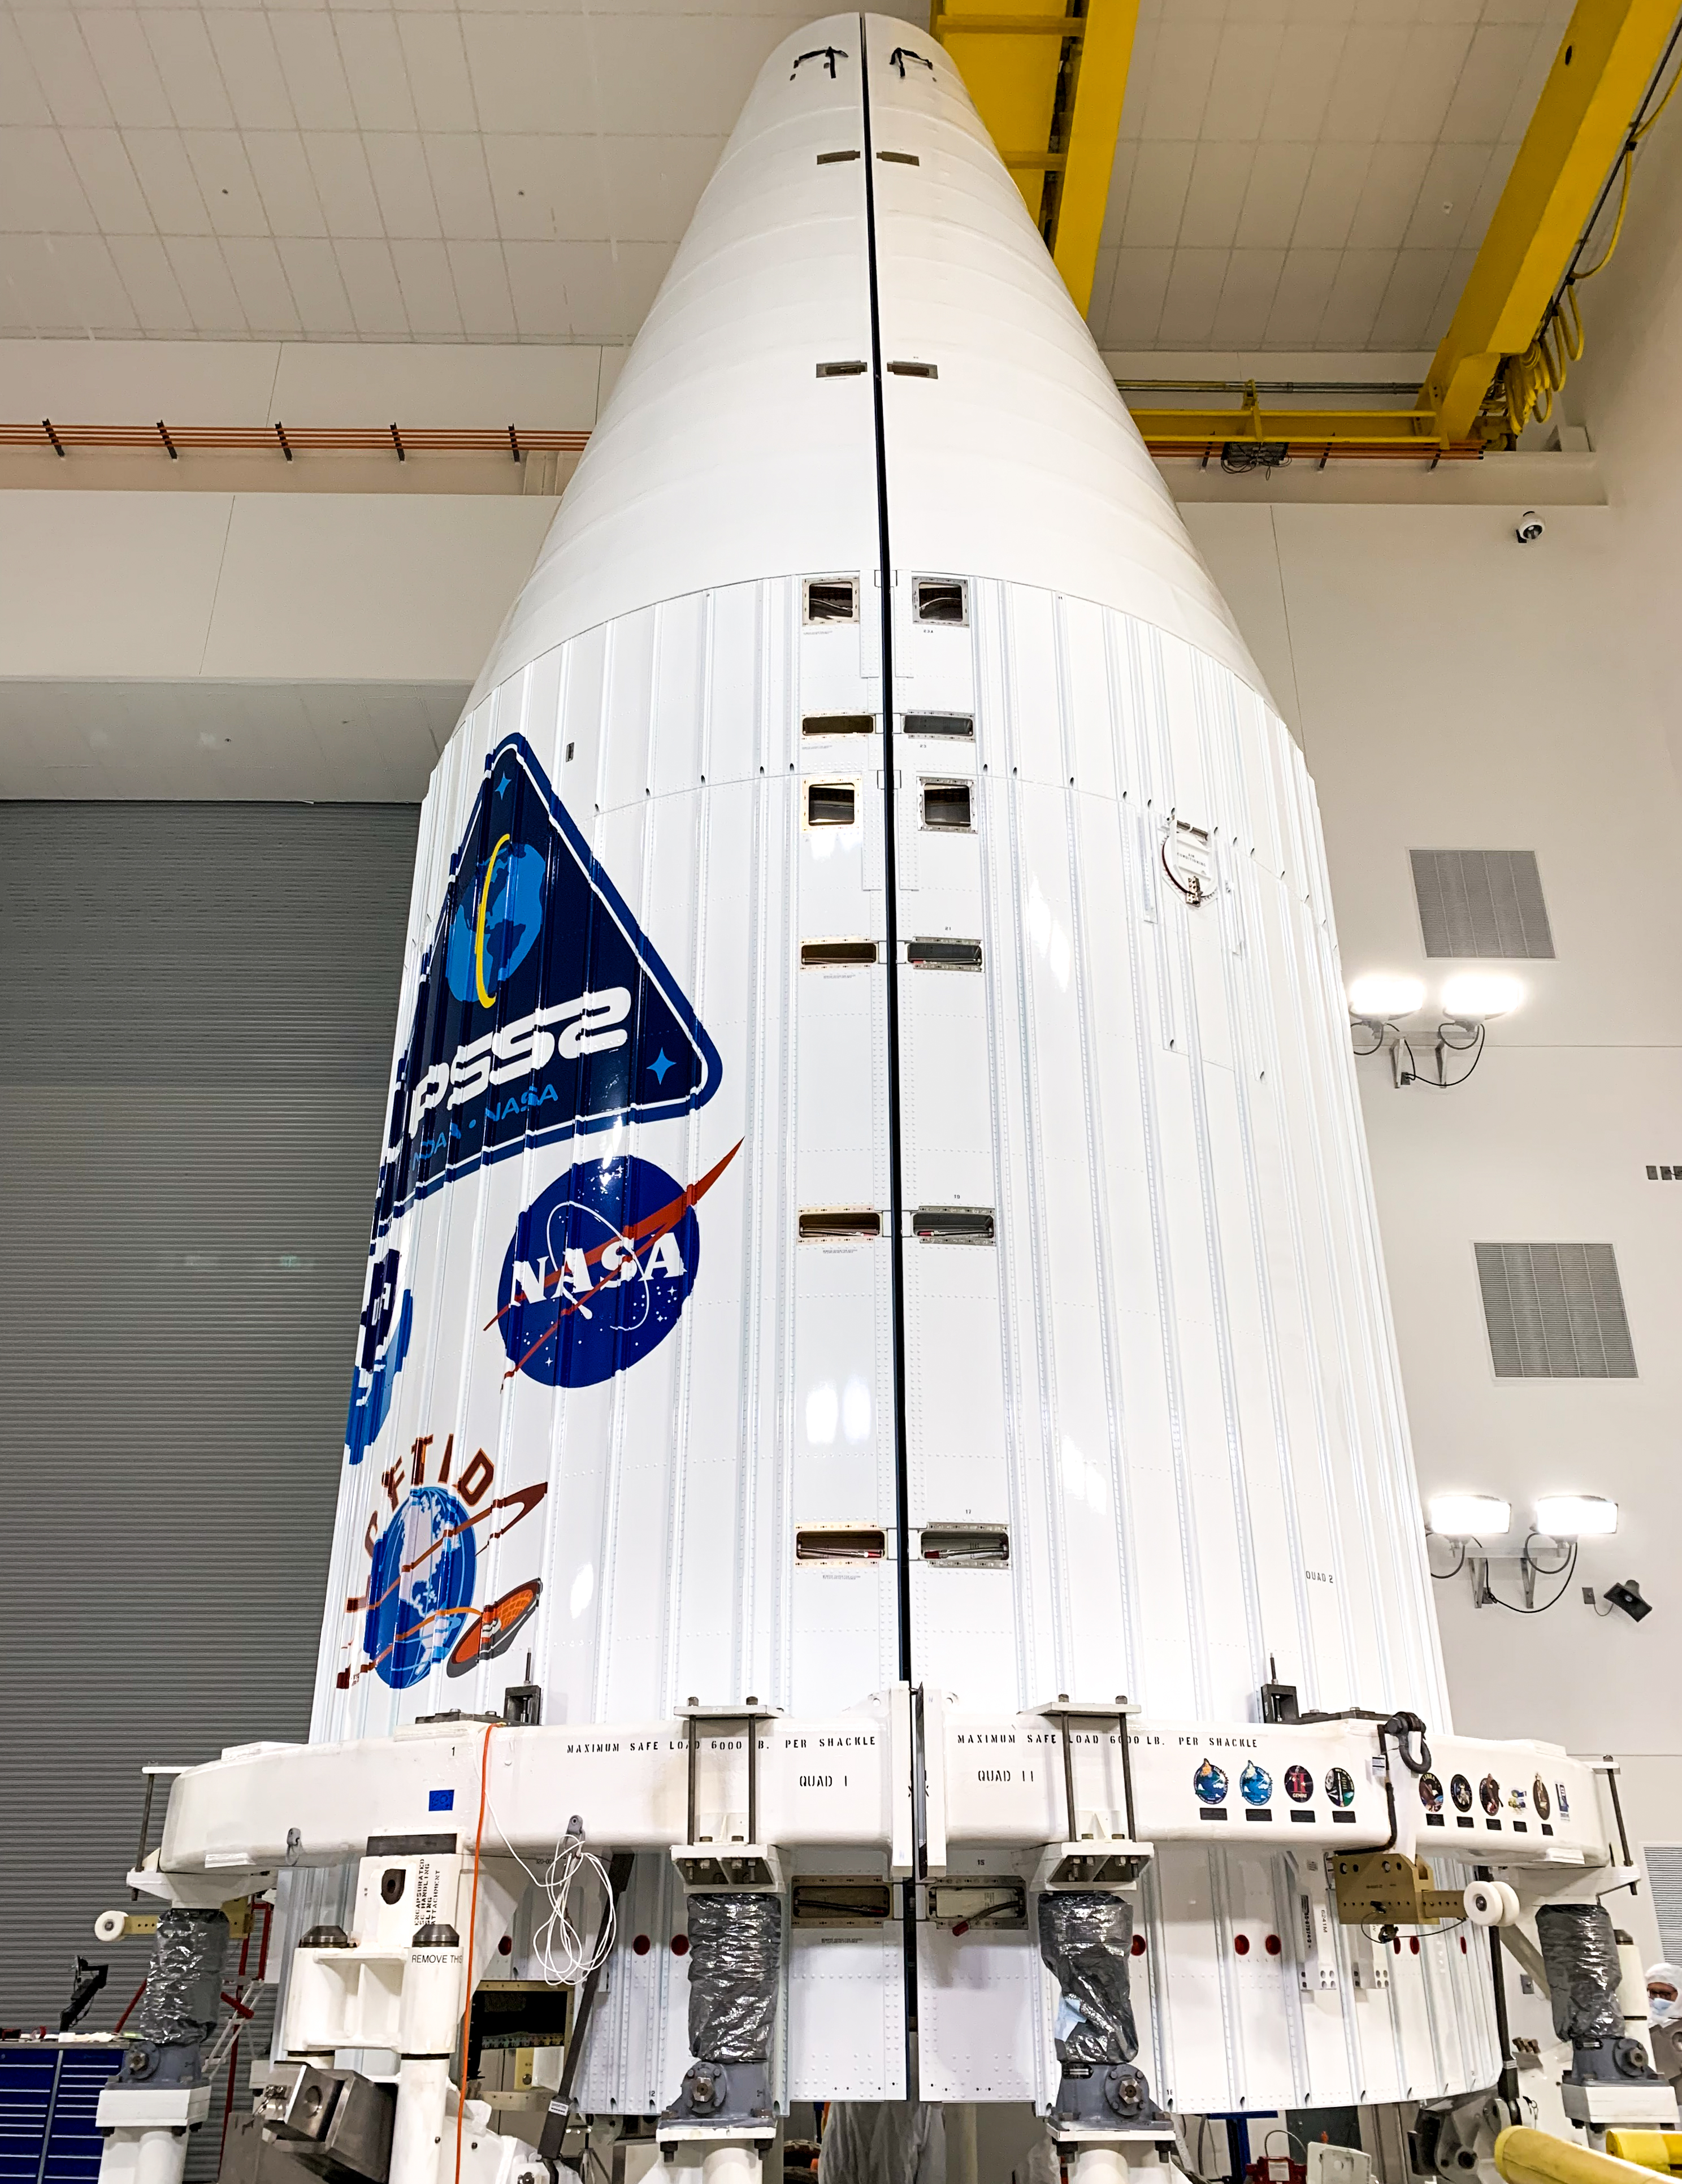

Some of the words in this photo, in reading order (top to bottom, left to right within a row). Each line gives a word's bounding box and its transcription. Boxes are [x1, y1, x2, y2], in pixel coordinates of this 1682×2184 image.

[485, 1084, 558, 1122] NASA
[509, 1232, 688, 1307] NASA
[567, 1743, 619, 1753] MAXIMUM
[630, 1741, 658, 1751] SAFE
[711, 1740, 742, 1750] 6000
[785, 1739, 807, 1748] PER
[819, 1736, 876, 1747] SHACKLE
[957, 1734, 1016, 1744] MAXIMUM
[1027, 1734, 1057, 1744] SAFE
[1147, 1736, 1165, 1746] LB.
[1178, 1737, 1199, 1746] PER
[1209, 1737, 1258, 1748] SHACKLE
[799, 1775, 833, 1787] QUAD
[978, 1770, 1011, 1782] QUAD
[421, 1863, 430, 1909] HANDLING
[431, 1870, 440, 1925] ATTACHMENT
[411, 1955, 448, 1963] REMOVE
